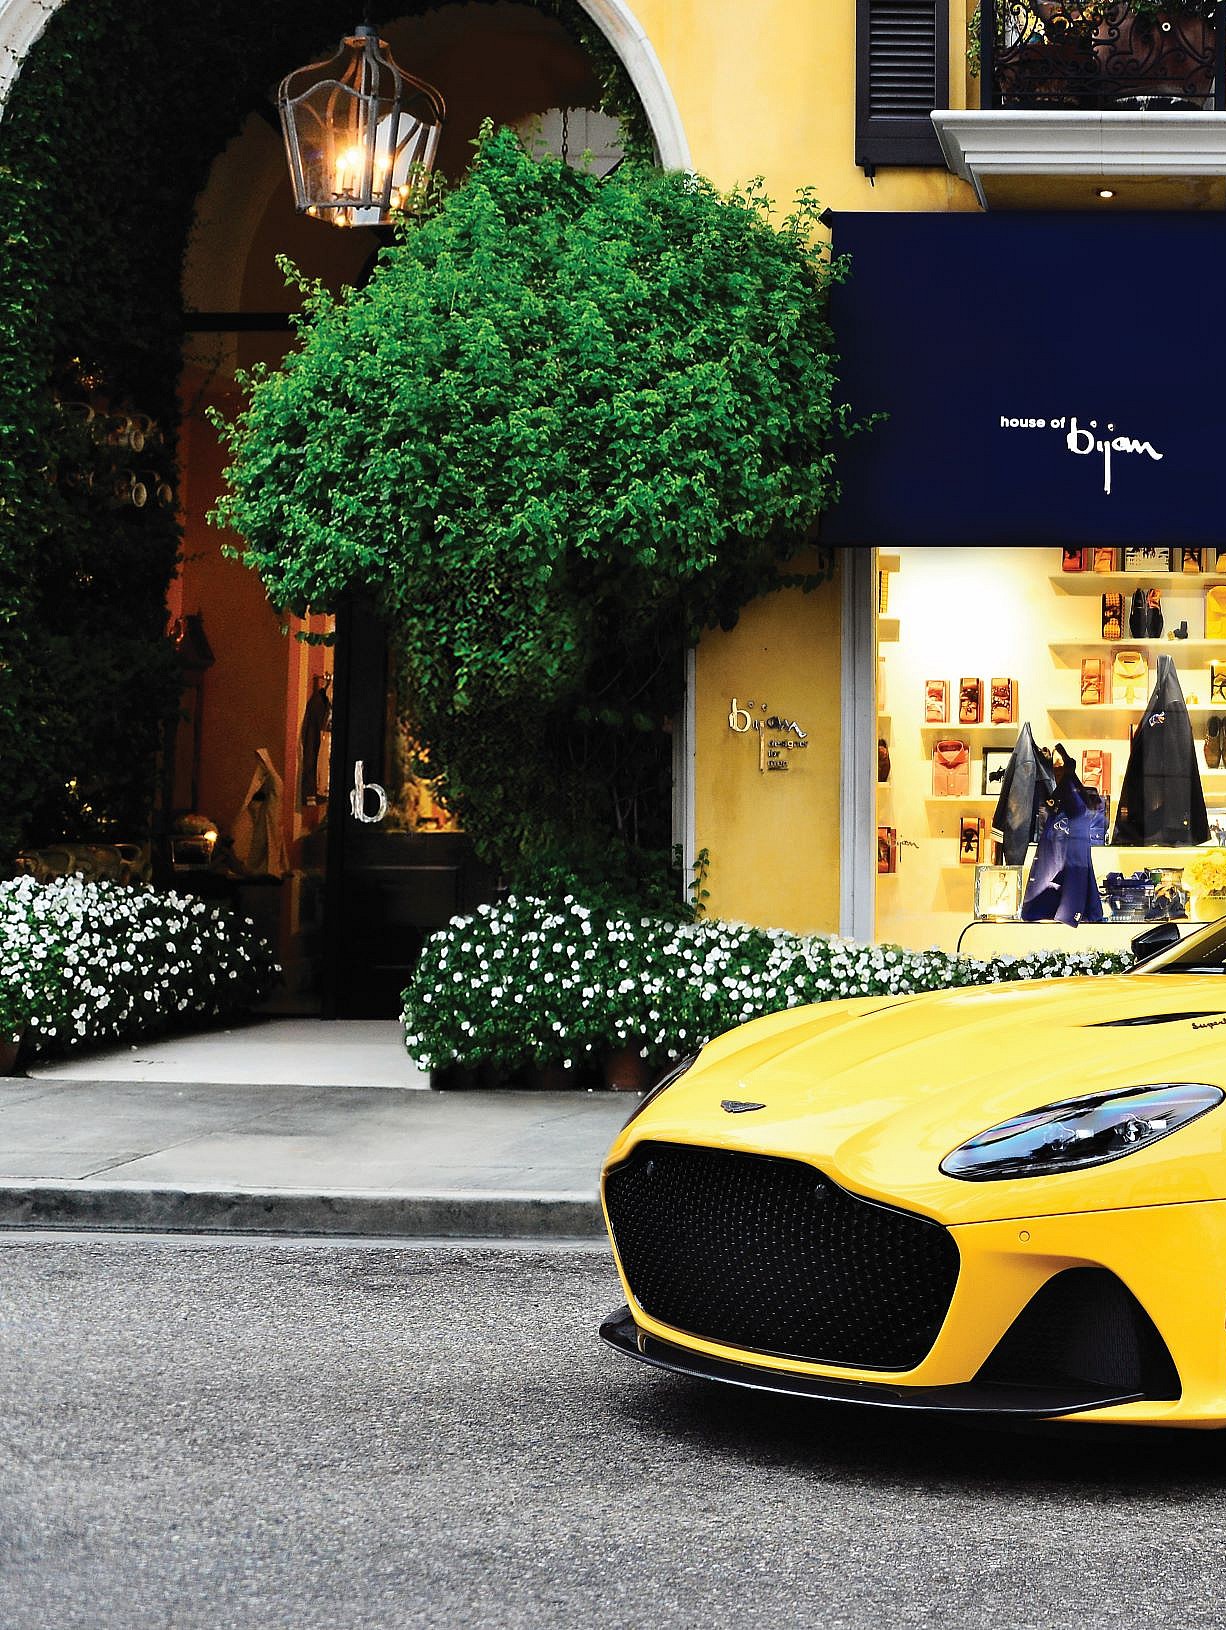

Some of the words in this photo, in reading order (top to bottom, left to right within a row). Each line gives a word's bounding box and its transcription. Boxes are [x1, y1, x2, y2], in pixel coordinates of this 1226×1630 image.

[1000, 416, 1046, 428] house
[1050, 417, 1066, 428] of
[1066, 417, 1164, 495] bijan
[728, 698, 808, 774] bijan
